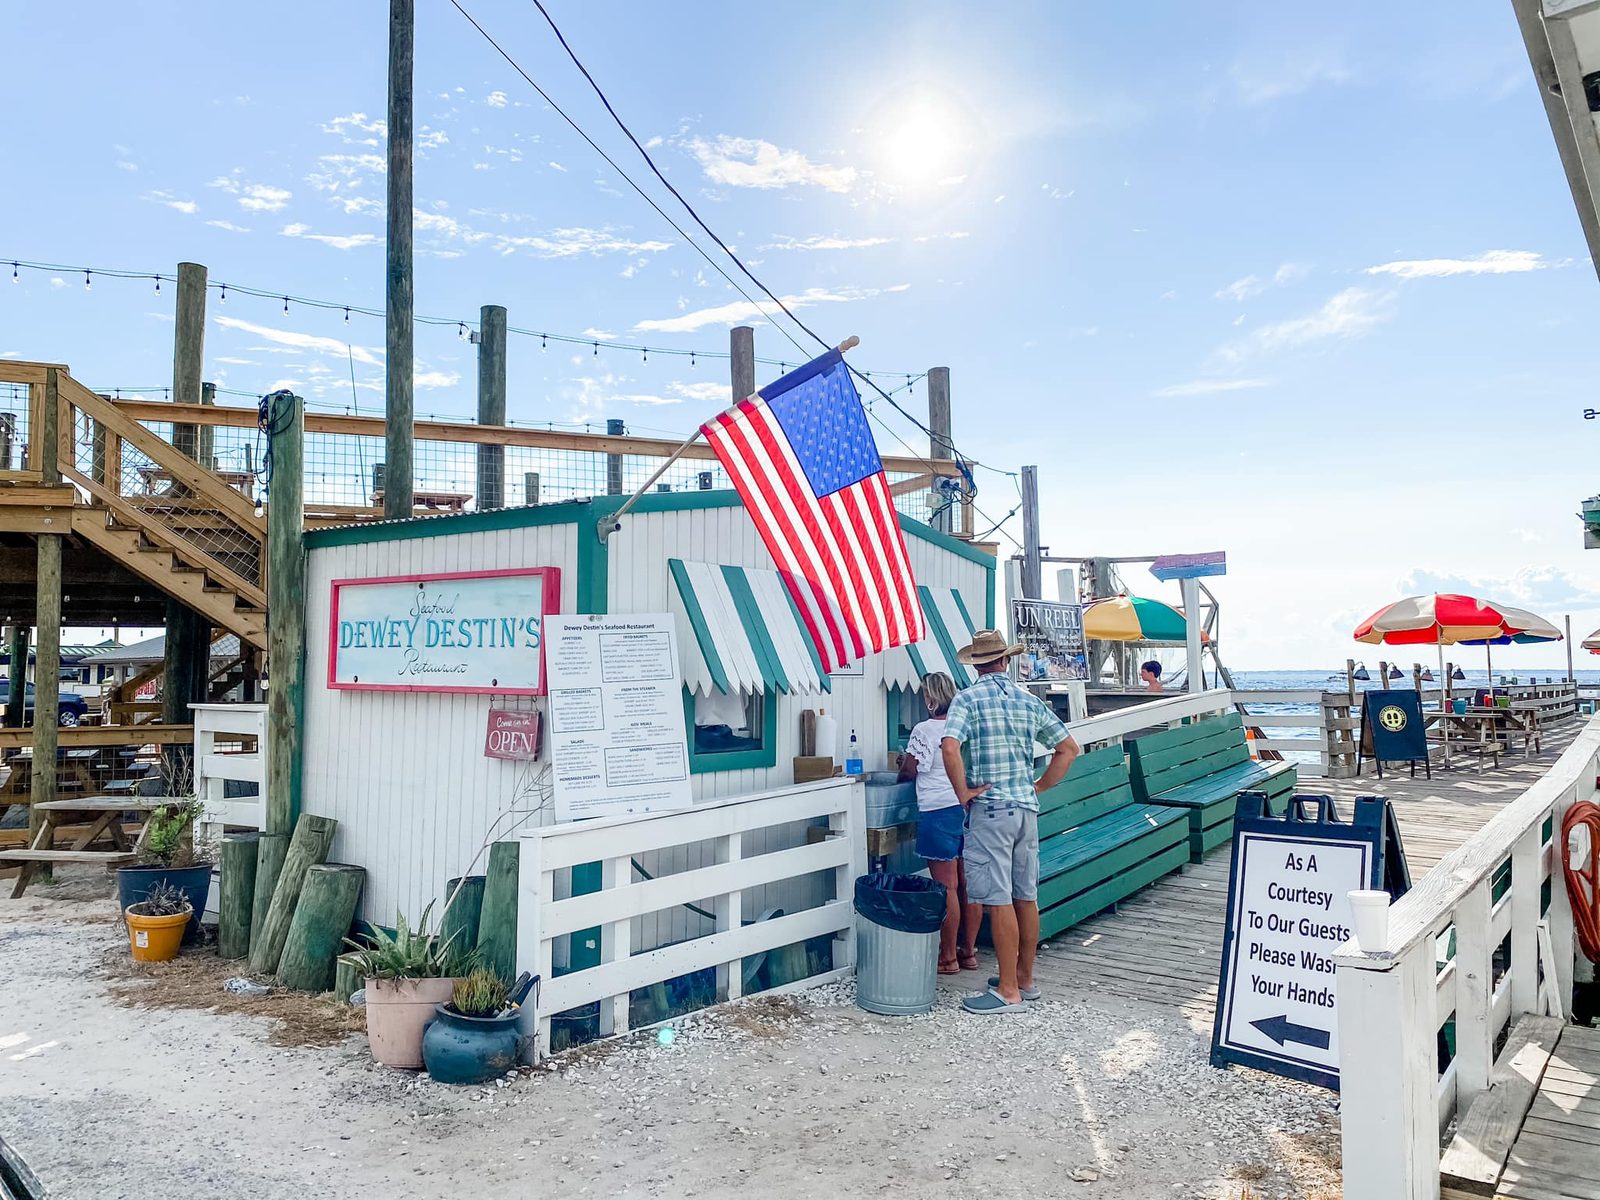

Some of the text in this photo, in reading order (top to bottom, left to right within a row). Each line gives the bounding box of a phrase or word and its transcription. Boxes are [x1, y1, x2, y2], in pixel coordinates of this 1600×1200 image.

[410, 591, 460, 621] Seafood
[1016, 606, 1081, 631] UN REEL
[339, 614, 541, 649] DEWEY DESTIN'S
[398, 648, 469, 676] Restaurant
[496, 716, 512, 728] Come
[489, 730, 535, 753] OPEN
[1285, 852, 1318, 873] As A
[1268, 882, 1333, 911] Courtesy
[1248, 910, 1350, 943] To Our Guests
[1249, 942, 1296, 968] Please
[1251, 974, 1335, 1009] Your Hands
